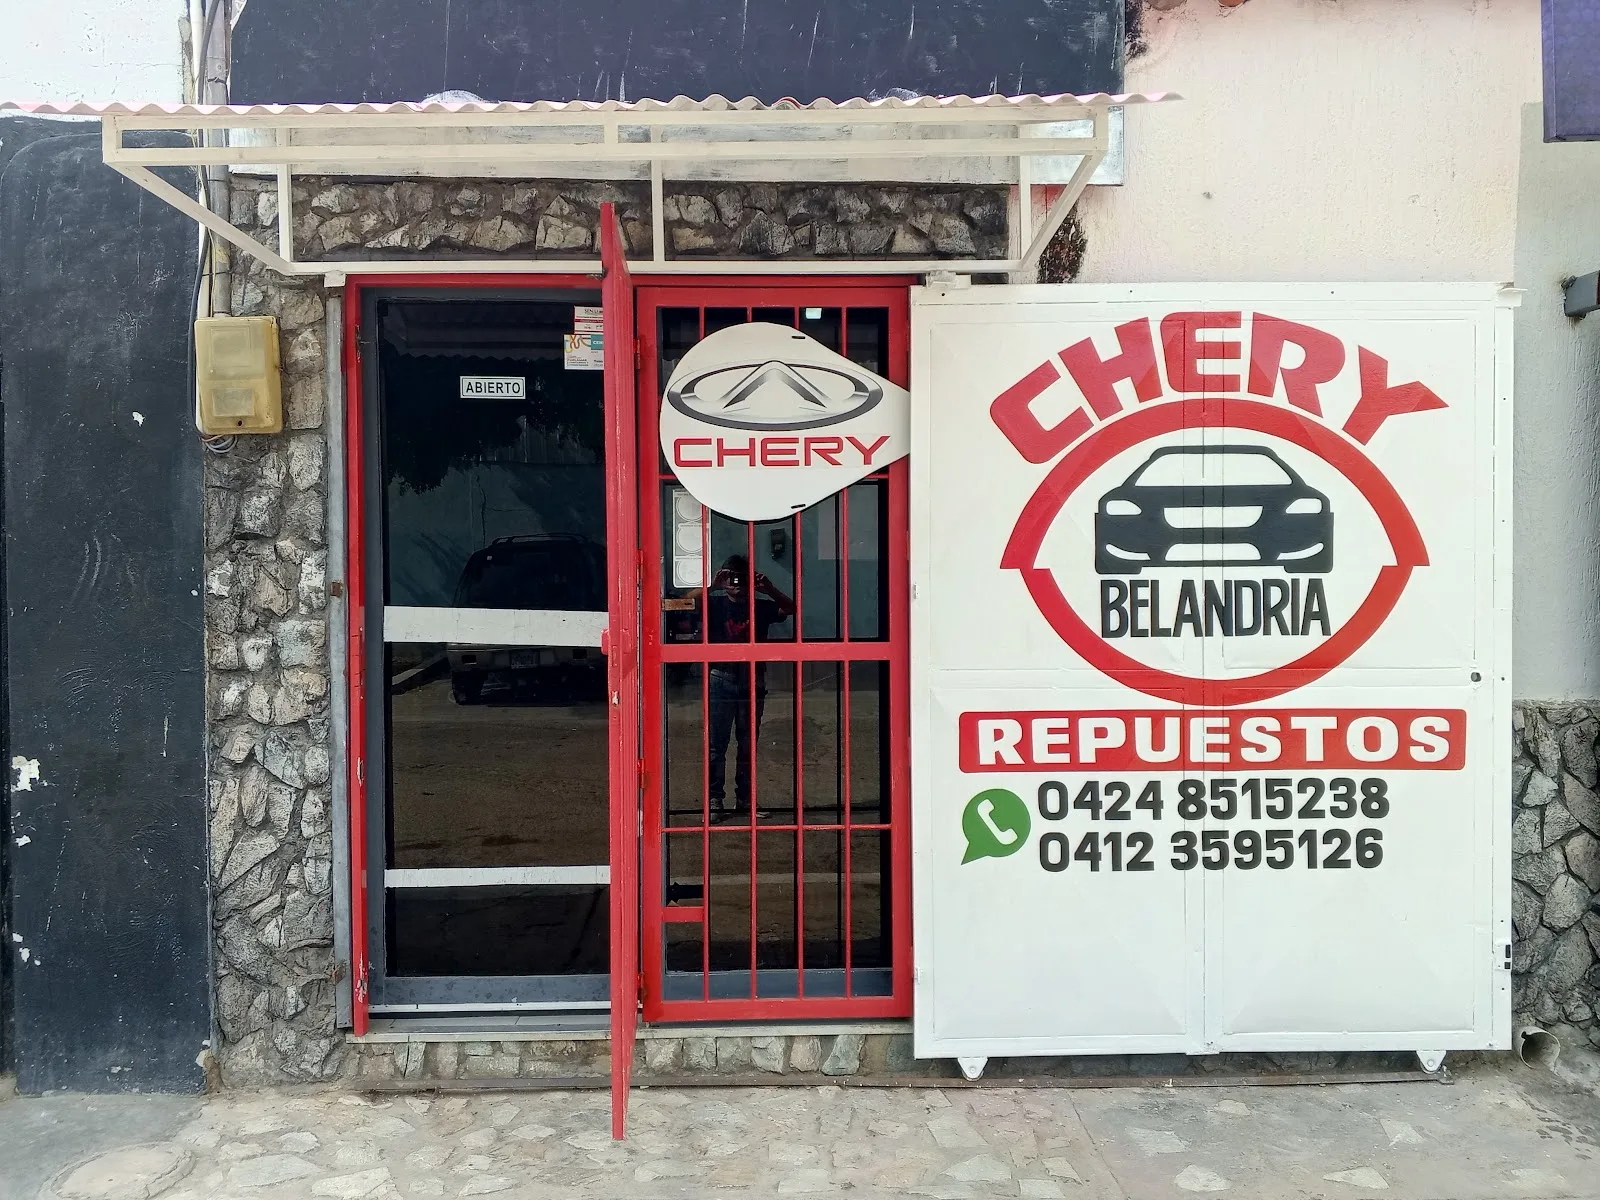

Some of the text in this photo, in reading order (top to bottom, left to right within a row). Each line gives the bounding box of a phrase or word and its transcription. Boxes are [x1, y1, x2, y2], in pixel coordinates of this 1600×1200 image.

[466, 381, 521, 394] ABIERTO
[990, 311, 1449, 464] CHERY
[673, 436, 889, 468] CHERY
[1100, 578, 1331, 638] BELANDRIA
[977, 716, 1452, 766] REPUESTOS
[1037, 778, 1390, 821] 0424 8515238
[1039, 828, 1384, 872] 0412 3595126
